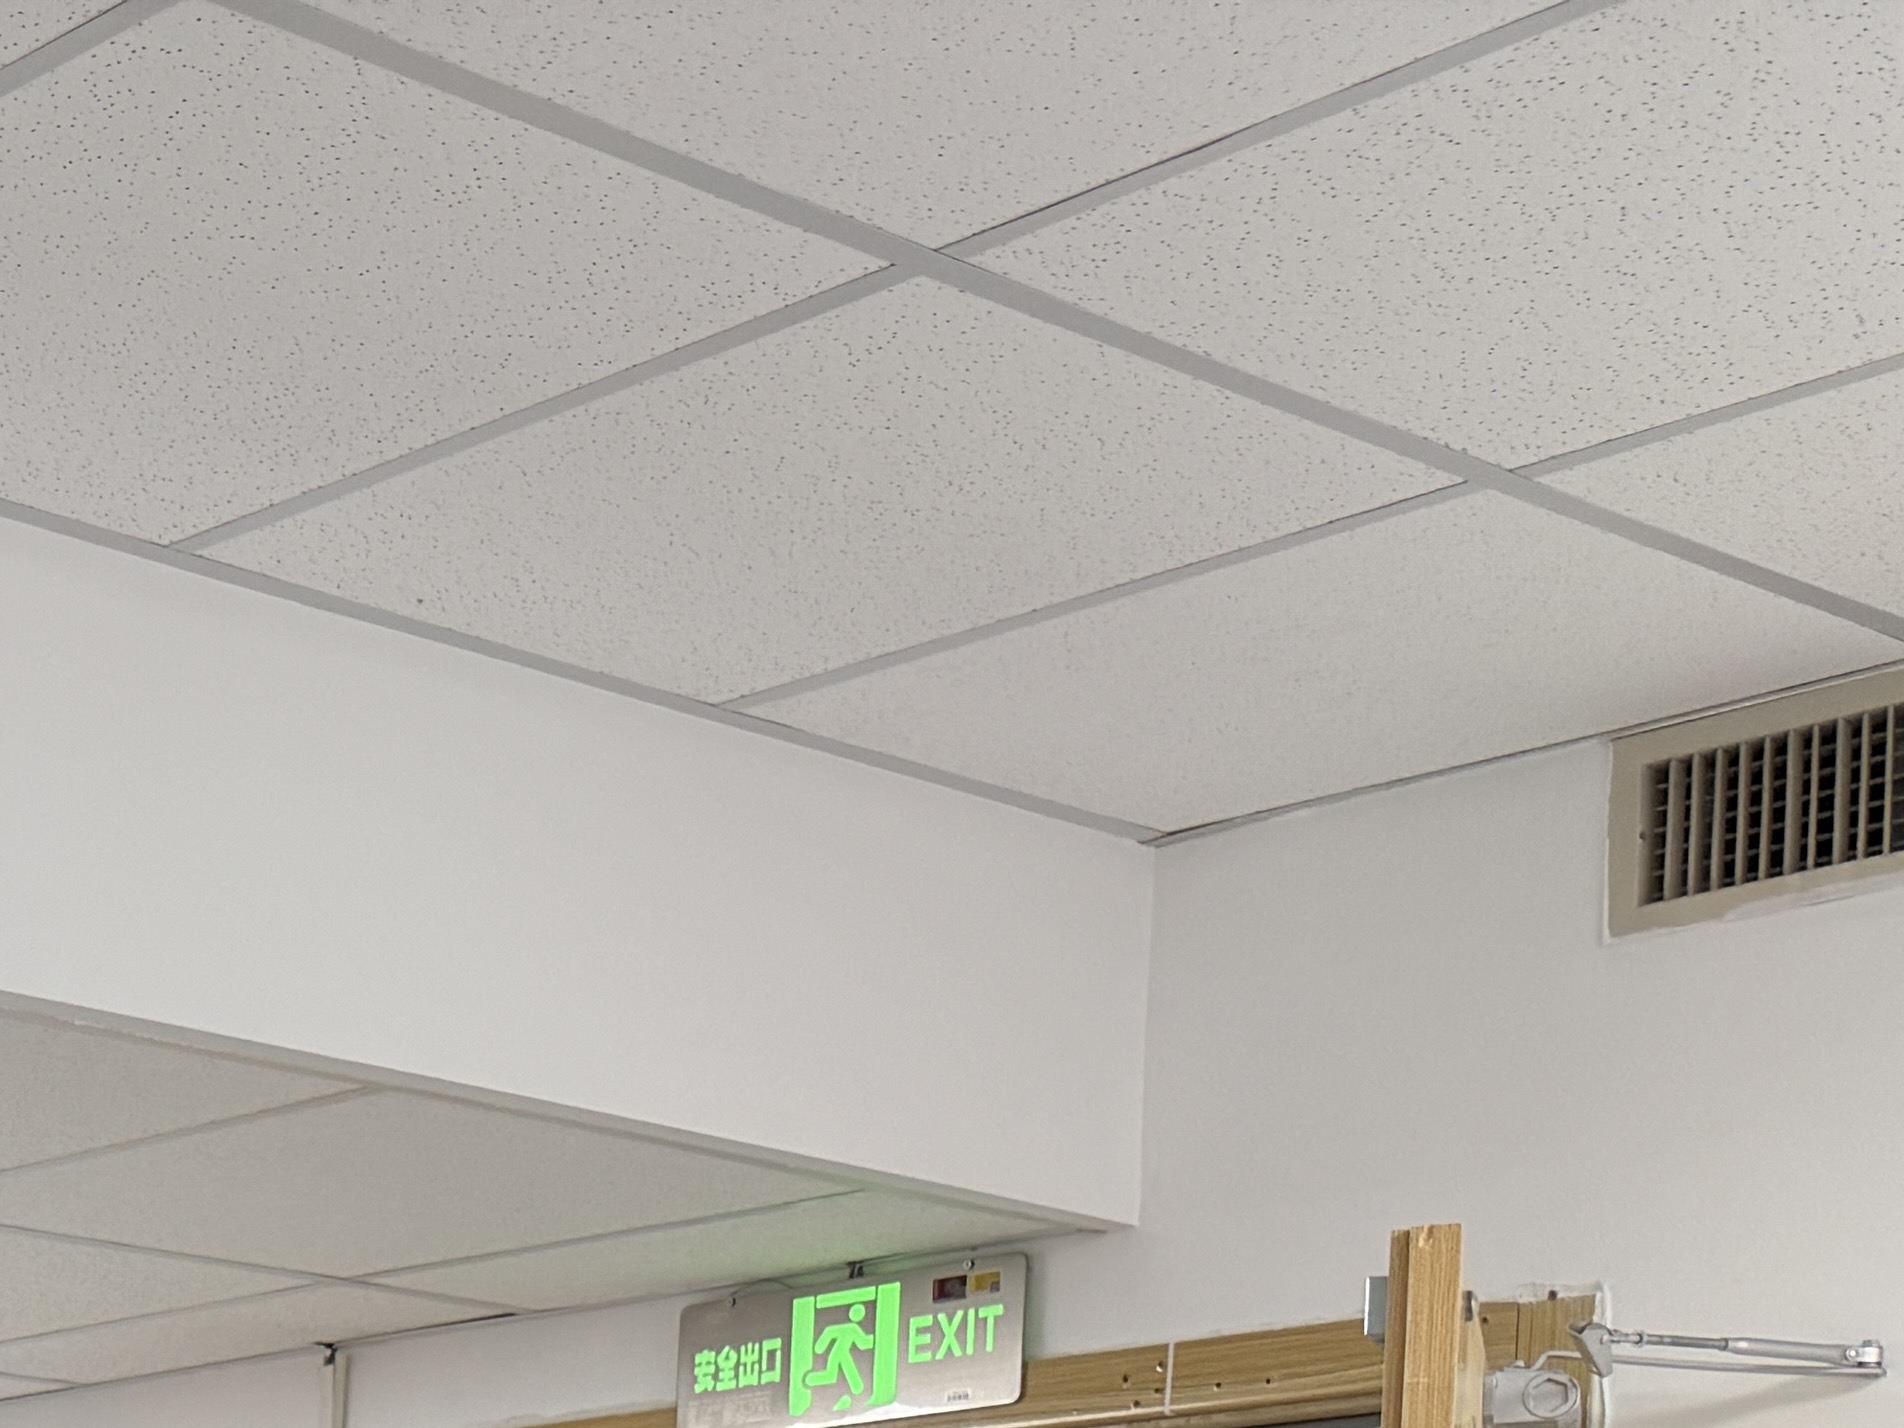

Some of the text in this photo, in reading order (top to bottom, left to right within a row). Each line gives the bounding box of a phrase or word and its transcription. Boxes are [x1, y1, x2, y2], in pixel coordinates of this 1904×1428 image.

[908, 1304, 1004, 1363] EXIT
[694, 1337, 782, 1394] 安全出口
